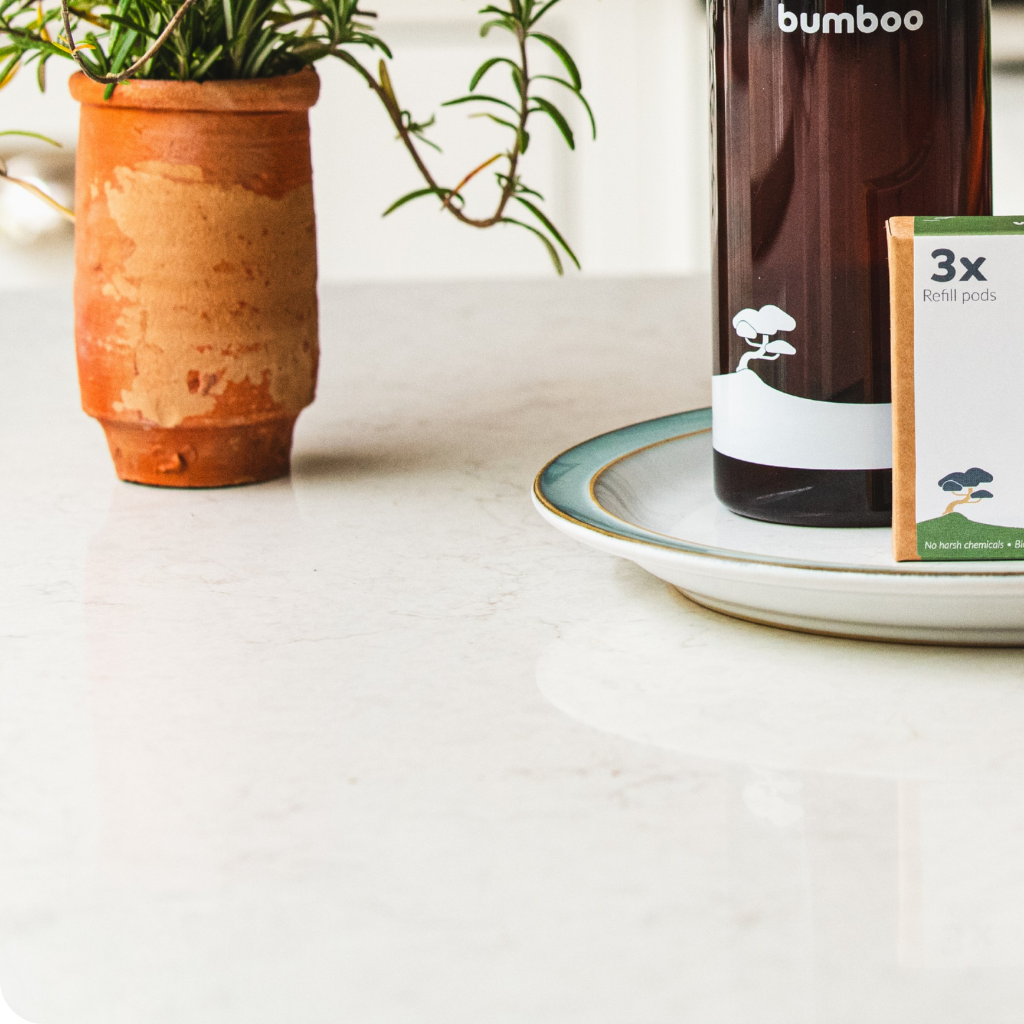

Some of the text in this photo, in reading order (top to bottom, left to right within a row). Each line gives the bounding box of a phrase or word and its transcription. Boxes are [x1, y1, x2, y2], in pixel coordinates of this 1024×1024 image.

[778, 3, 923, 33] bumboo
[931, 249, 987, 282] 3x
[923, 288, 997, 304] Refill pods
[925, 541, 937, 549] No
[939, 541, 961, 549] harsh
[964, 540, 1003, 549] chemicals
